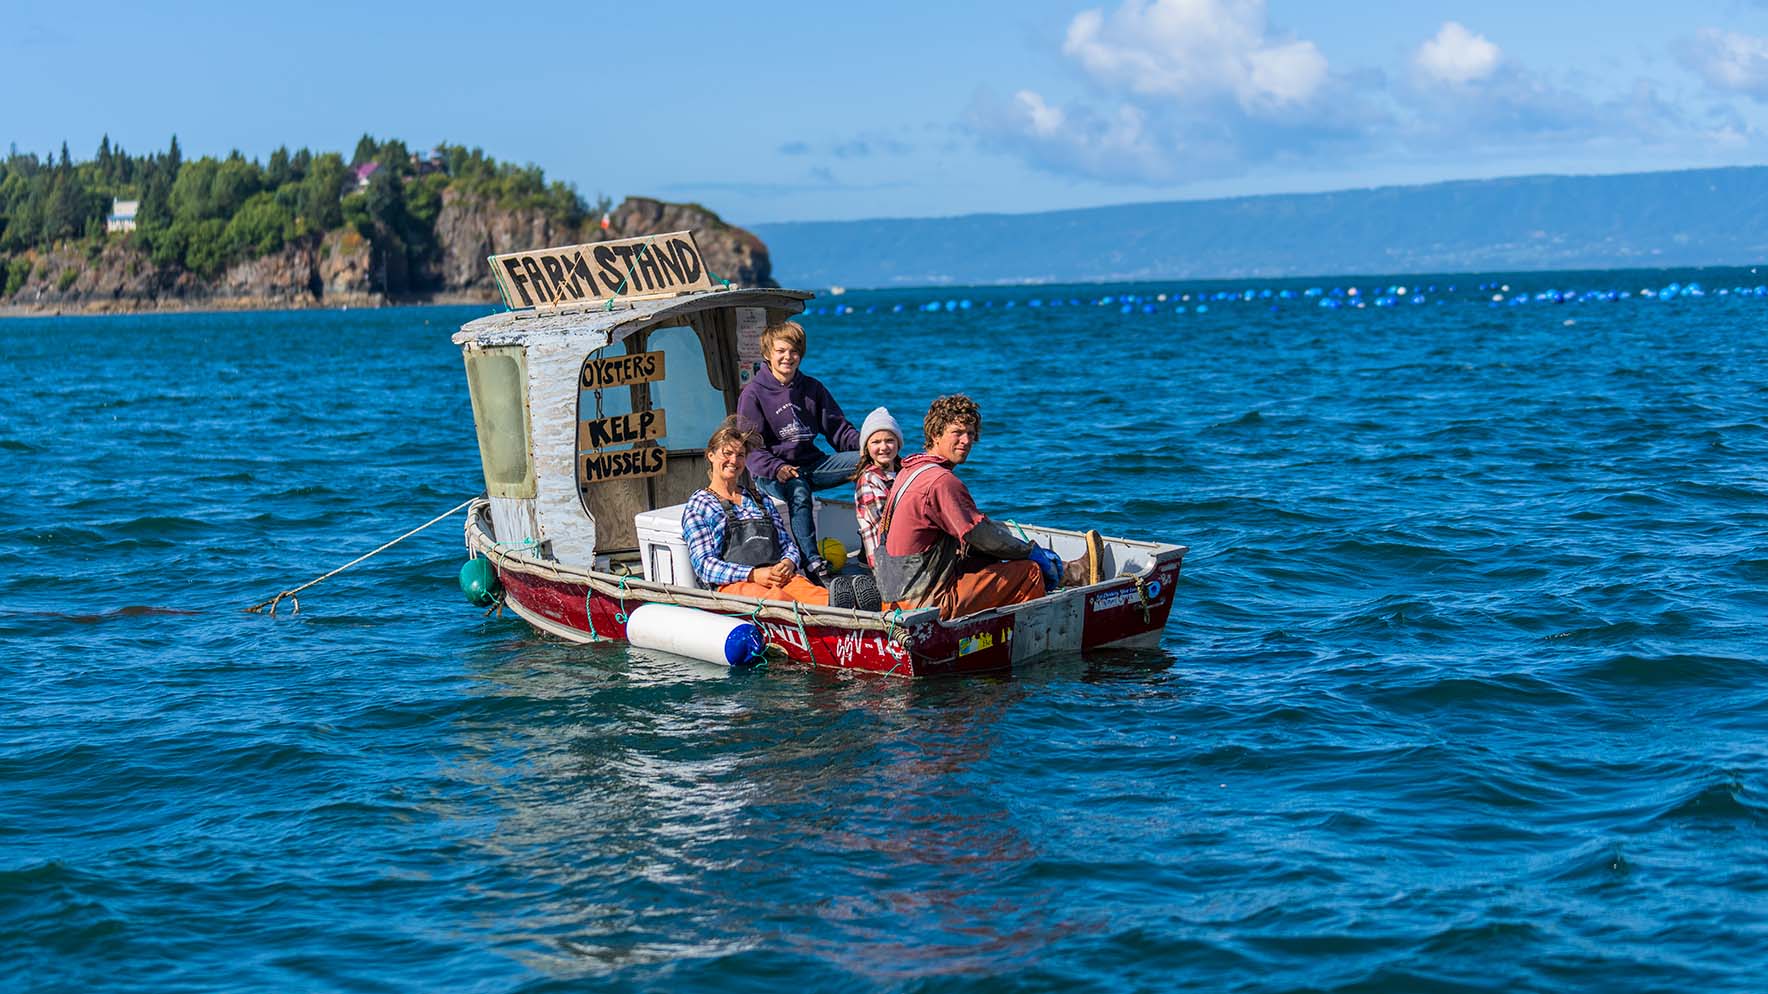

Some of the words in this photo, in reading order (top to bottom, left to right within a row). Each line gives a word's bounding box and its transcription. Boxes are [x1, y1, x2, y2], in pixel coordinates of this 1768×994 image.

[502, 250, 600, 307] FARM
[593, 238, 701, 296] STAND
[582, 356, 656, 388] OYSTERS
[586, 448, 664, 481] MUSSELS
